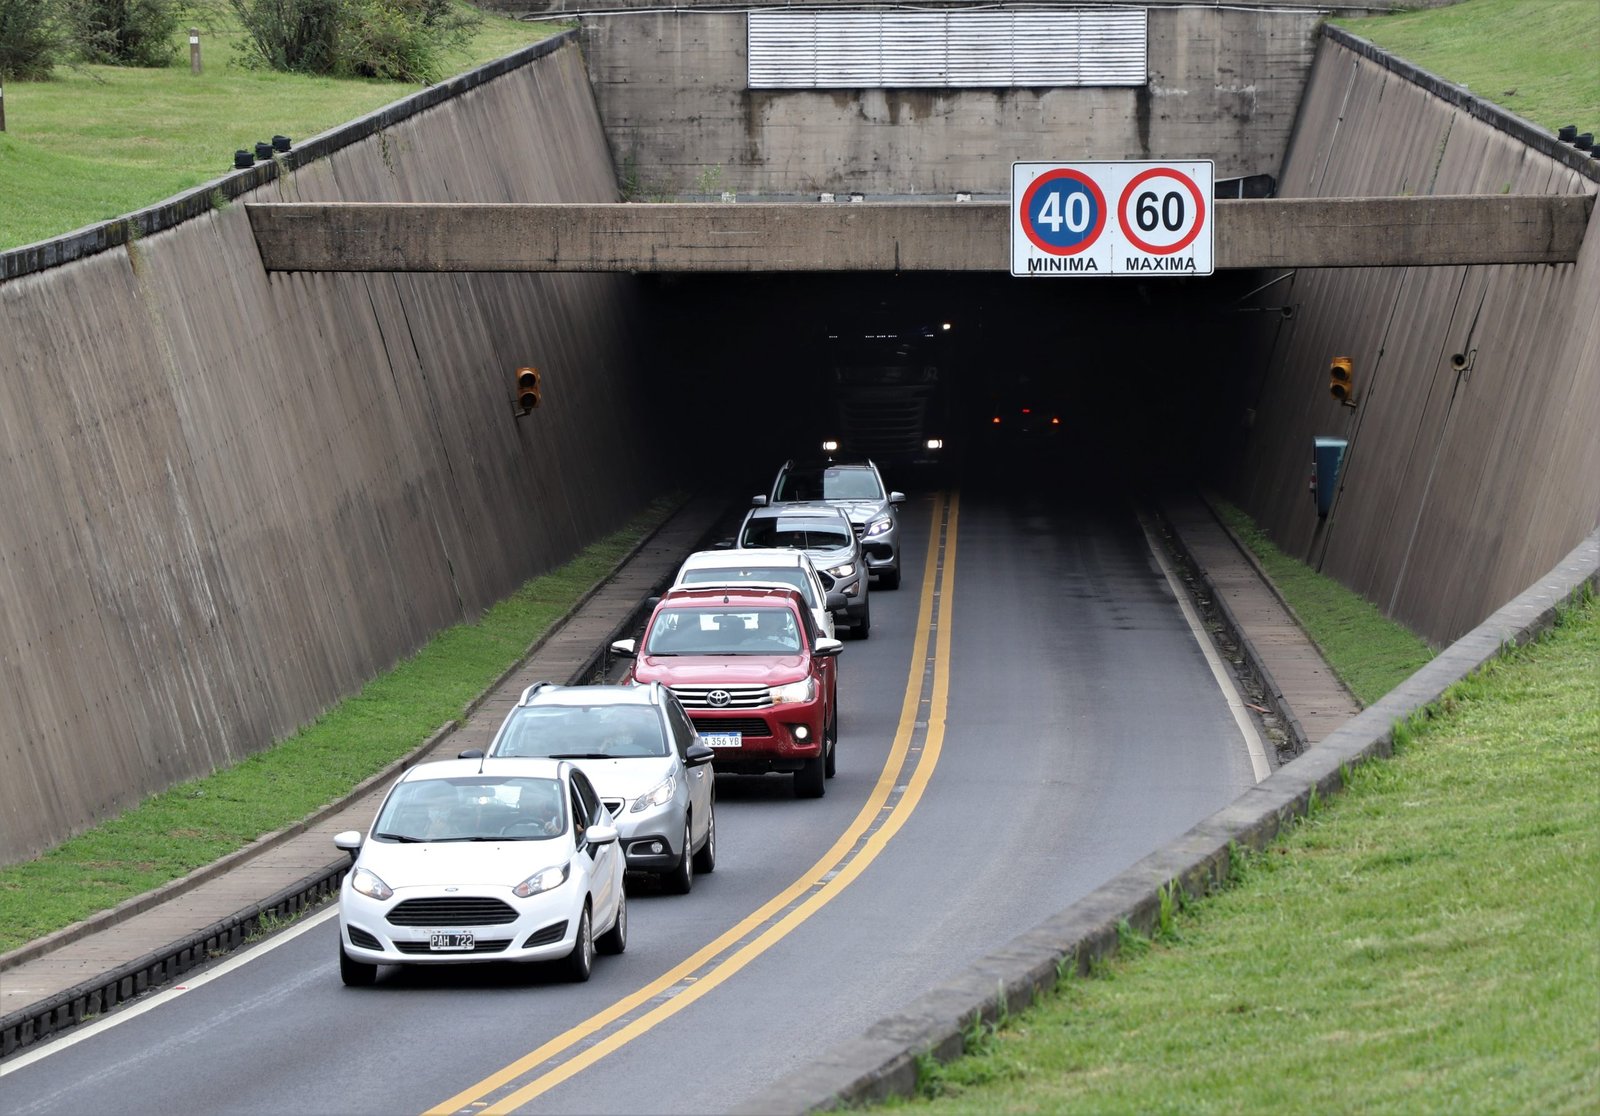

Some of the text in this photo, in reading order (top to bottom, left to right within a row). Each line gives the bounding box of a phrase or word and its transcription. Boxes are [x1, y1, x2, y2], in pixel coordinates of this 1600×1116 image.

[1038, 191, 1090, 232] 40
[1136, 191, 1185, 232] 60
[1027, 258, 1098, 271] MINIMA
[1126, 257, 1196, 270] MAXIMA
[711, 737, 727, 746] 356
[431, 935, 473, 946] PAH 722
